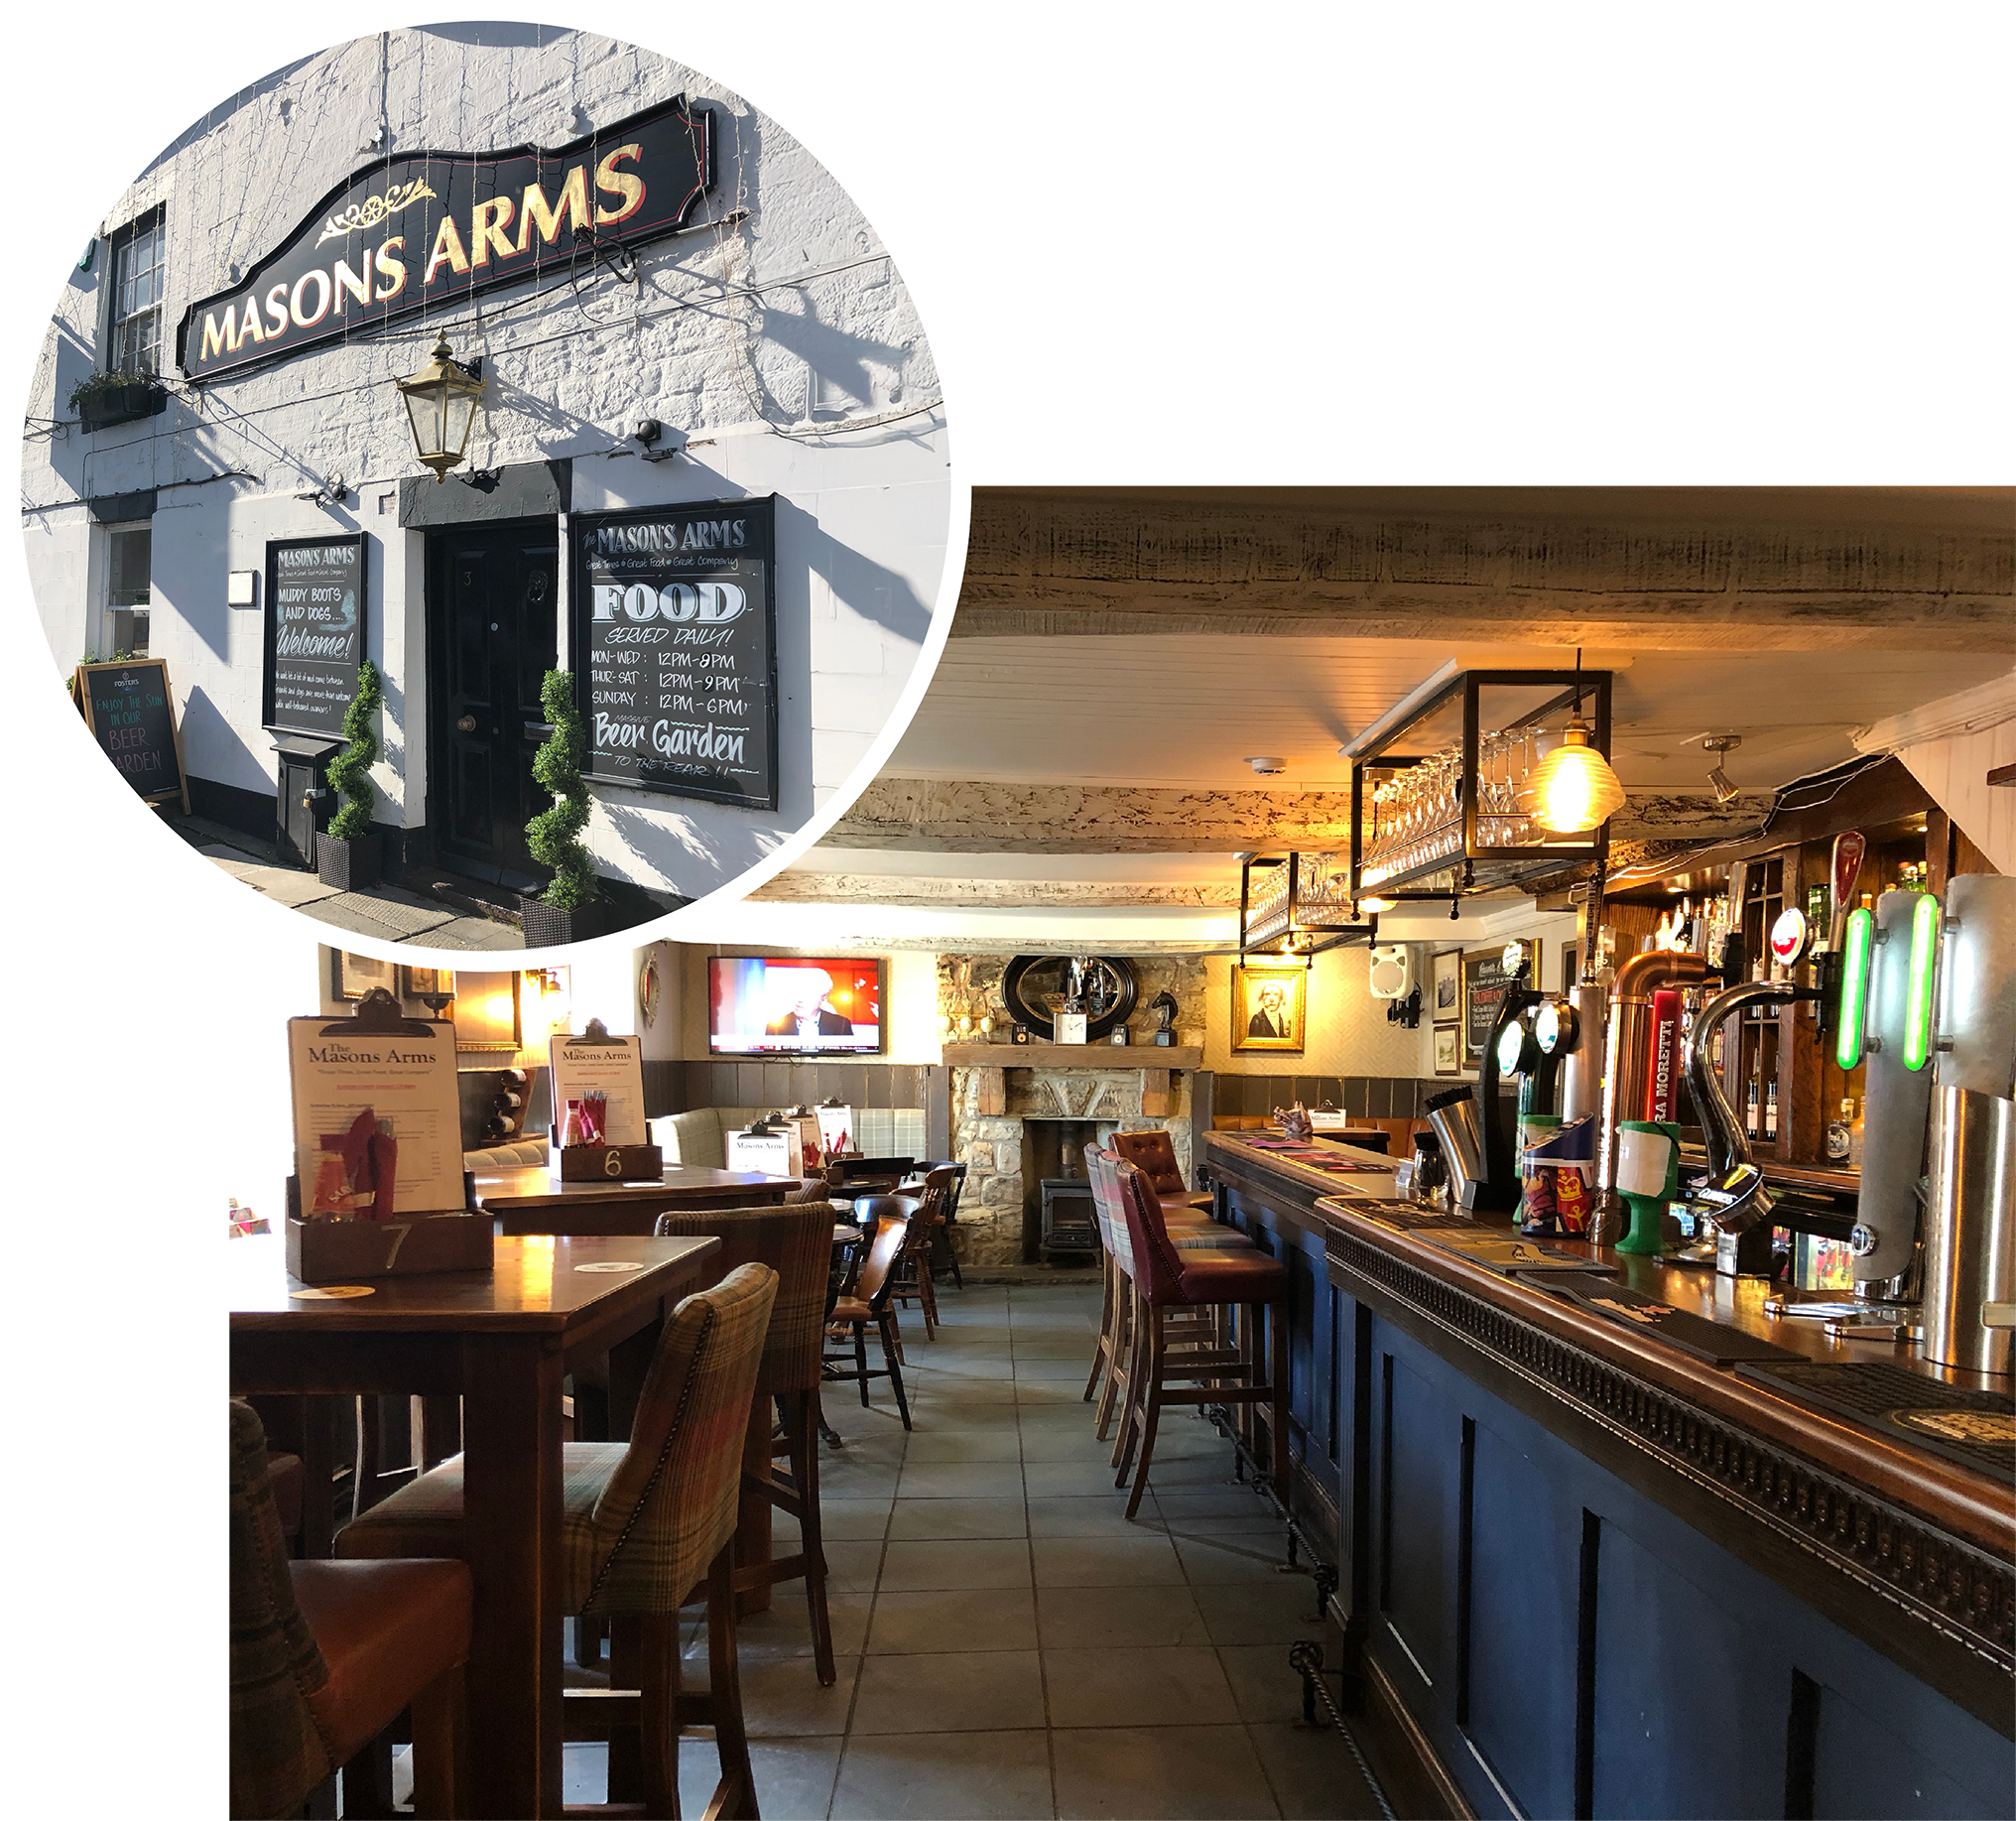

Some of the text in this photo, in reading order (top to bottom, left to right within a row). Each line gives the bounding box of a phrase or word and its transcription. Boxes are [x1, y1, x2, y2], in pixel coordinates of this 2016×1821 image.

[200, 143, 646, 361] MASONS ARMS
[597, 523, 678, 554] MASON'S
[681, 520, 749, 550] ARMS
[321, 547, 355, 566] ARMS
[626, 557, 648, 568] Great
[650, 557, 666, 567] Food
[673, 557, 694, 567] Great
[697, 556, 739, 570] Company
[463, 572, 472, 586] 3
[279, 587, 341, 602] MUDDY BOOTS
[591, 583, 746, 624] FOOD
[285, 606, 305, 620] AND
[277, 624, 354, 659] Welcome!
[605, 627, 734, 646] SERVED DAILY!
[96, 698, 123, 713] ENJOY
[146, 694, 163, 707] SUN
[110, 712, 142, 725] IN OUR
[109, 727, 151, 750] BEER
[594, 712, 744, 763] Beer Garden
[110, 750, 162, 773] ARDEN
[614, 755, 631, 766] TO
[636, 757, 660, 769] THE
[664, 761, 709, 777] REAR
[309, 1047, 437, 1064] Masons Arms
[328, 1043, 350, 1052] The
[563, 1051, 632, 1061] Masons Arms
[1656, 1020, 1674, 1098] MORETTI
[605, 1150, 622, 1176] 6
[381, 1224, 413, 1269] 7
